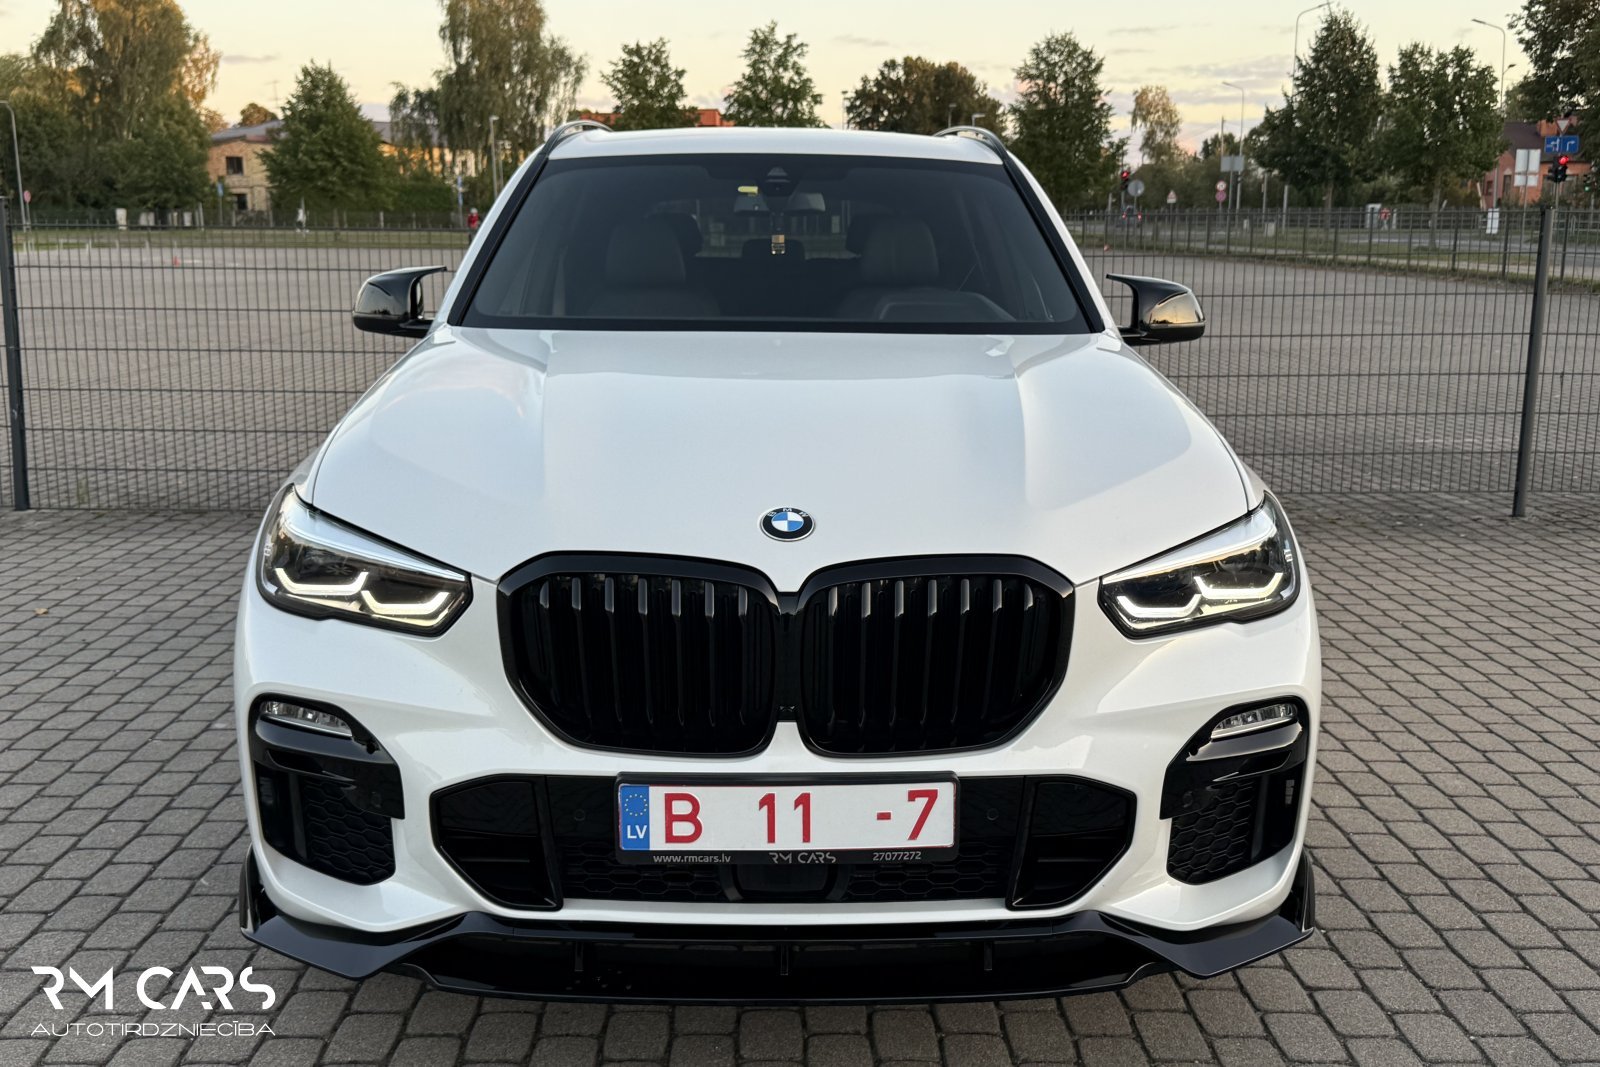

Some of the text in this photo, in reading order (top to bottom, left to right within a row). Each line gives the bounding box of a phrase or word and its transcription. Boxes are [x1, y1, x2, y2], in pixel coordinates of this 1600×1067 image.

[767, 507, 808, 517] BMW
[664, 792, 703, 844] B
[758, 792, 811, 844] 11
[627, 825, 647, 839] LV
[653, 851, 922, 864] www.rmcars.lv RM CARS 27077272
